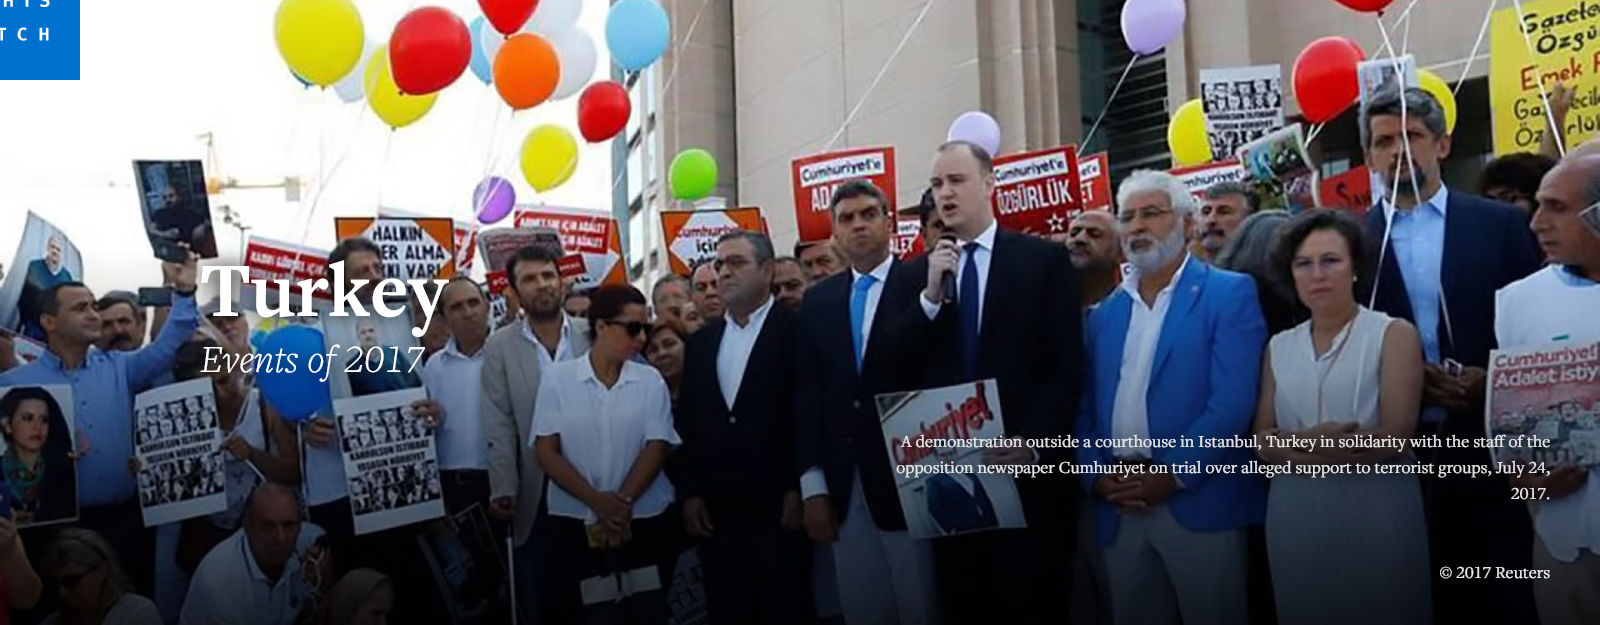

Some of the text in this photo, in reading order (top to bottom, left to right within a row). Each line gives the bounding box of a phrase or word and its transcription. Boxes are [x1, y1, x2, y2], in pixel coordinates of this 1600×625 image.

[1521, 57, 1582, 91] Emek
[997, 178, 1073, 215] ÖZGÜRLÜK
[372, 225, 423, 242] HALKIN
[405, 245, 446, 260] ALMA
